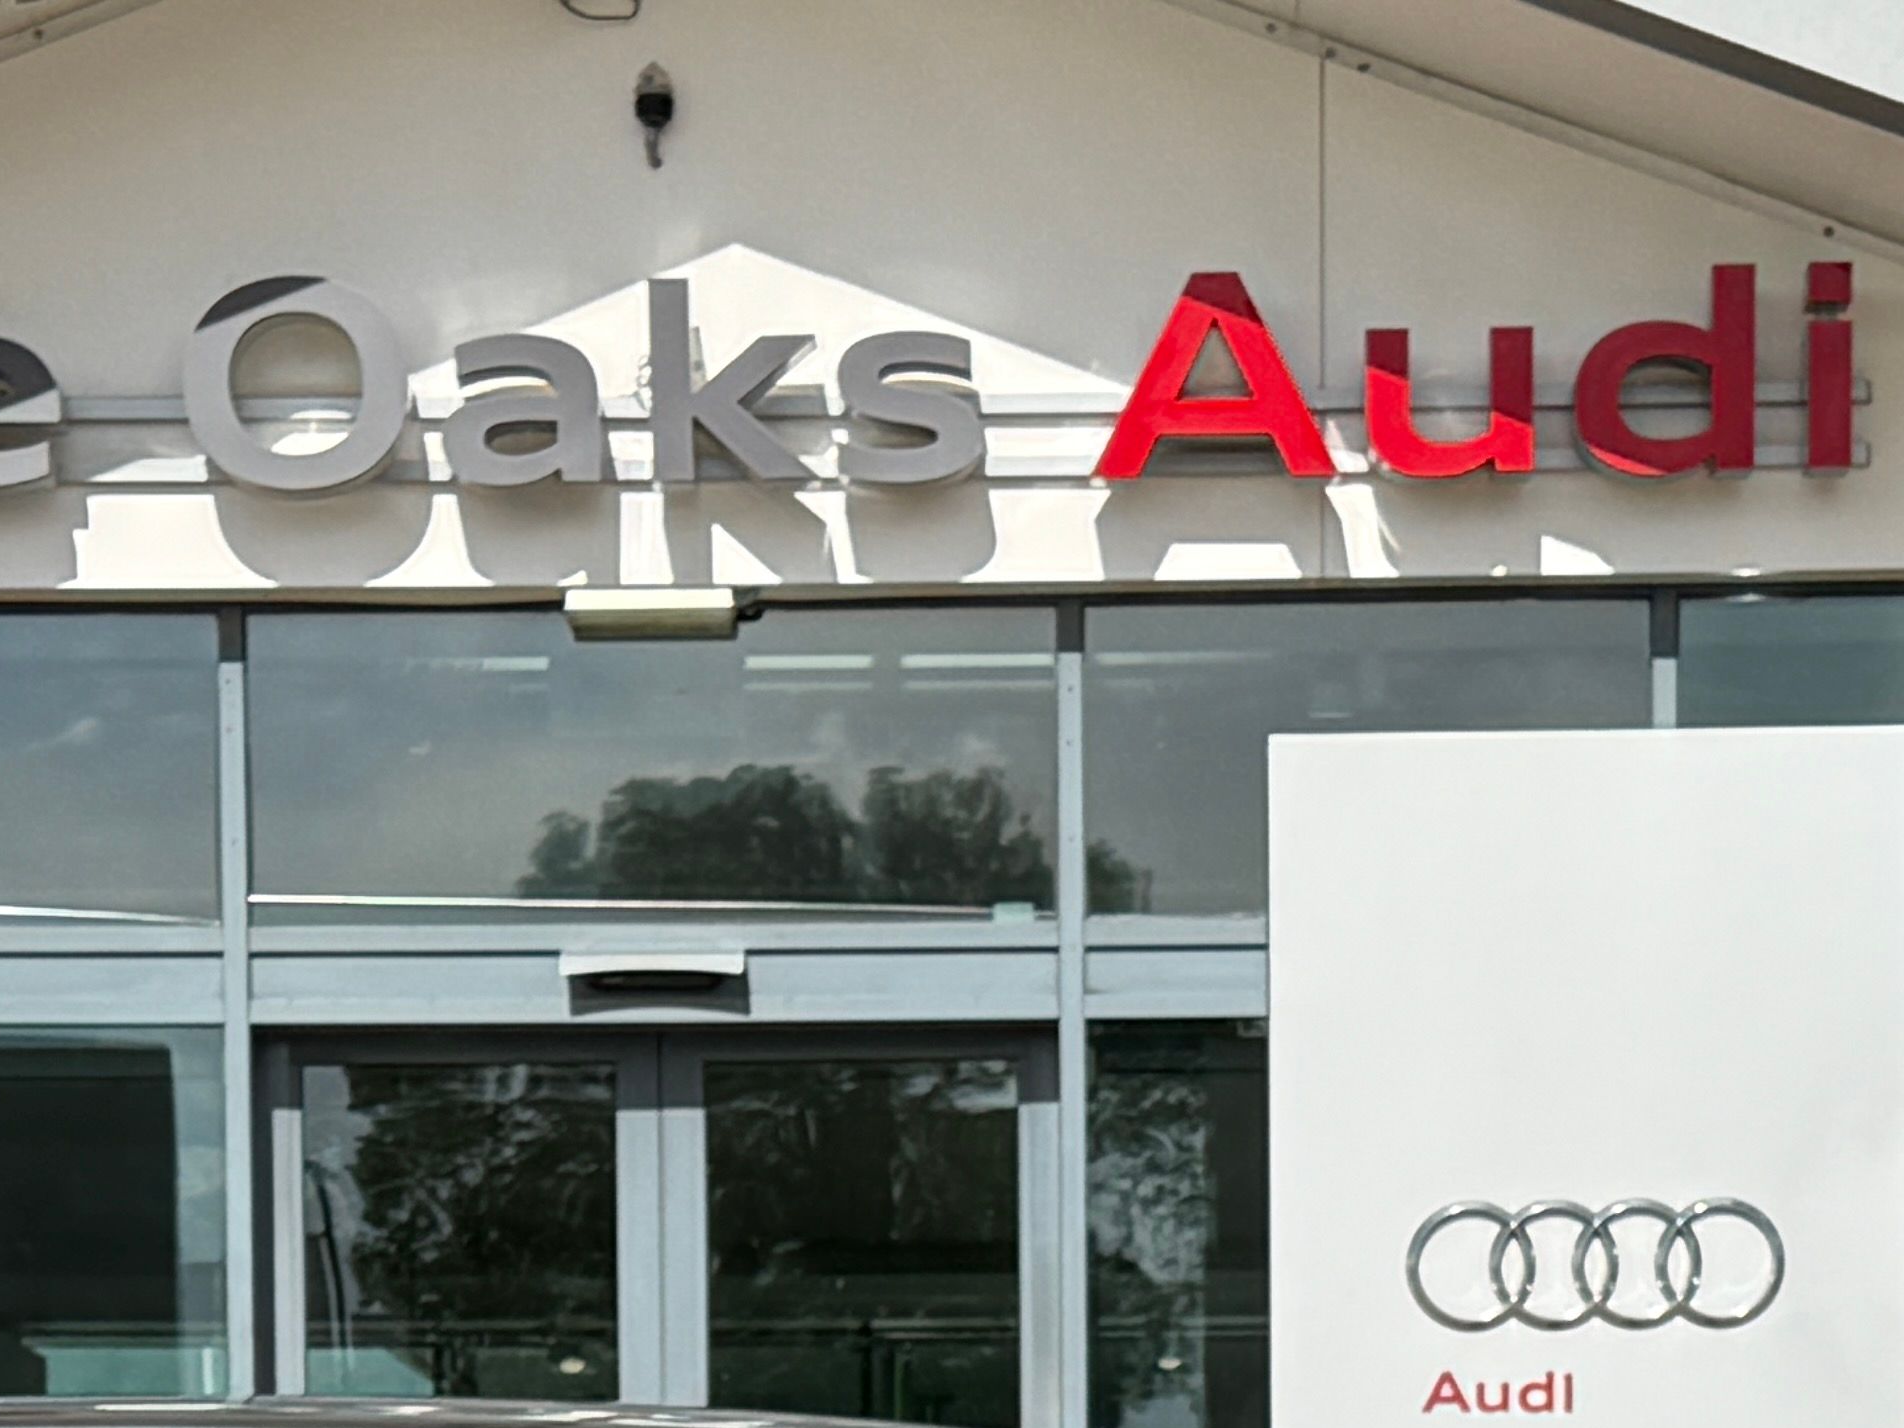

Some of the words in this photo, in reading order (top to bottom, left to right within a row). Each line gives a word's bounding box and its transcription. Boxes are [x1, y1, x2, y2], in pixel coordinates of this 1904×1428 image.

[181, 273, 986, 490] Oaks
[1090, 261, 1854, 481] Audi
[1421, 1370, 1574, 1415] Audi
